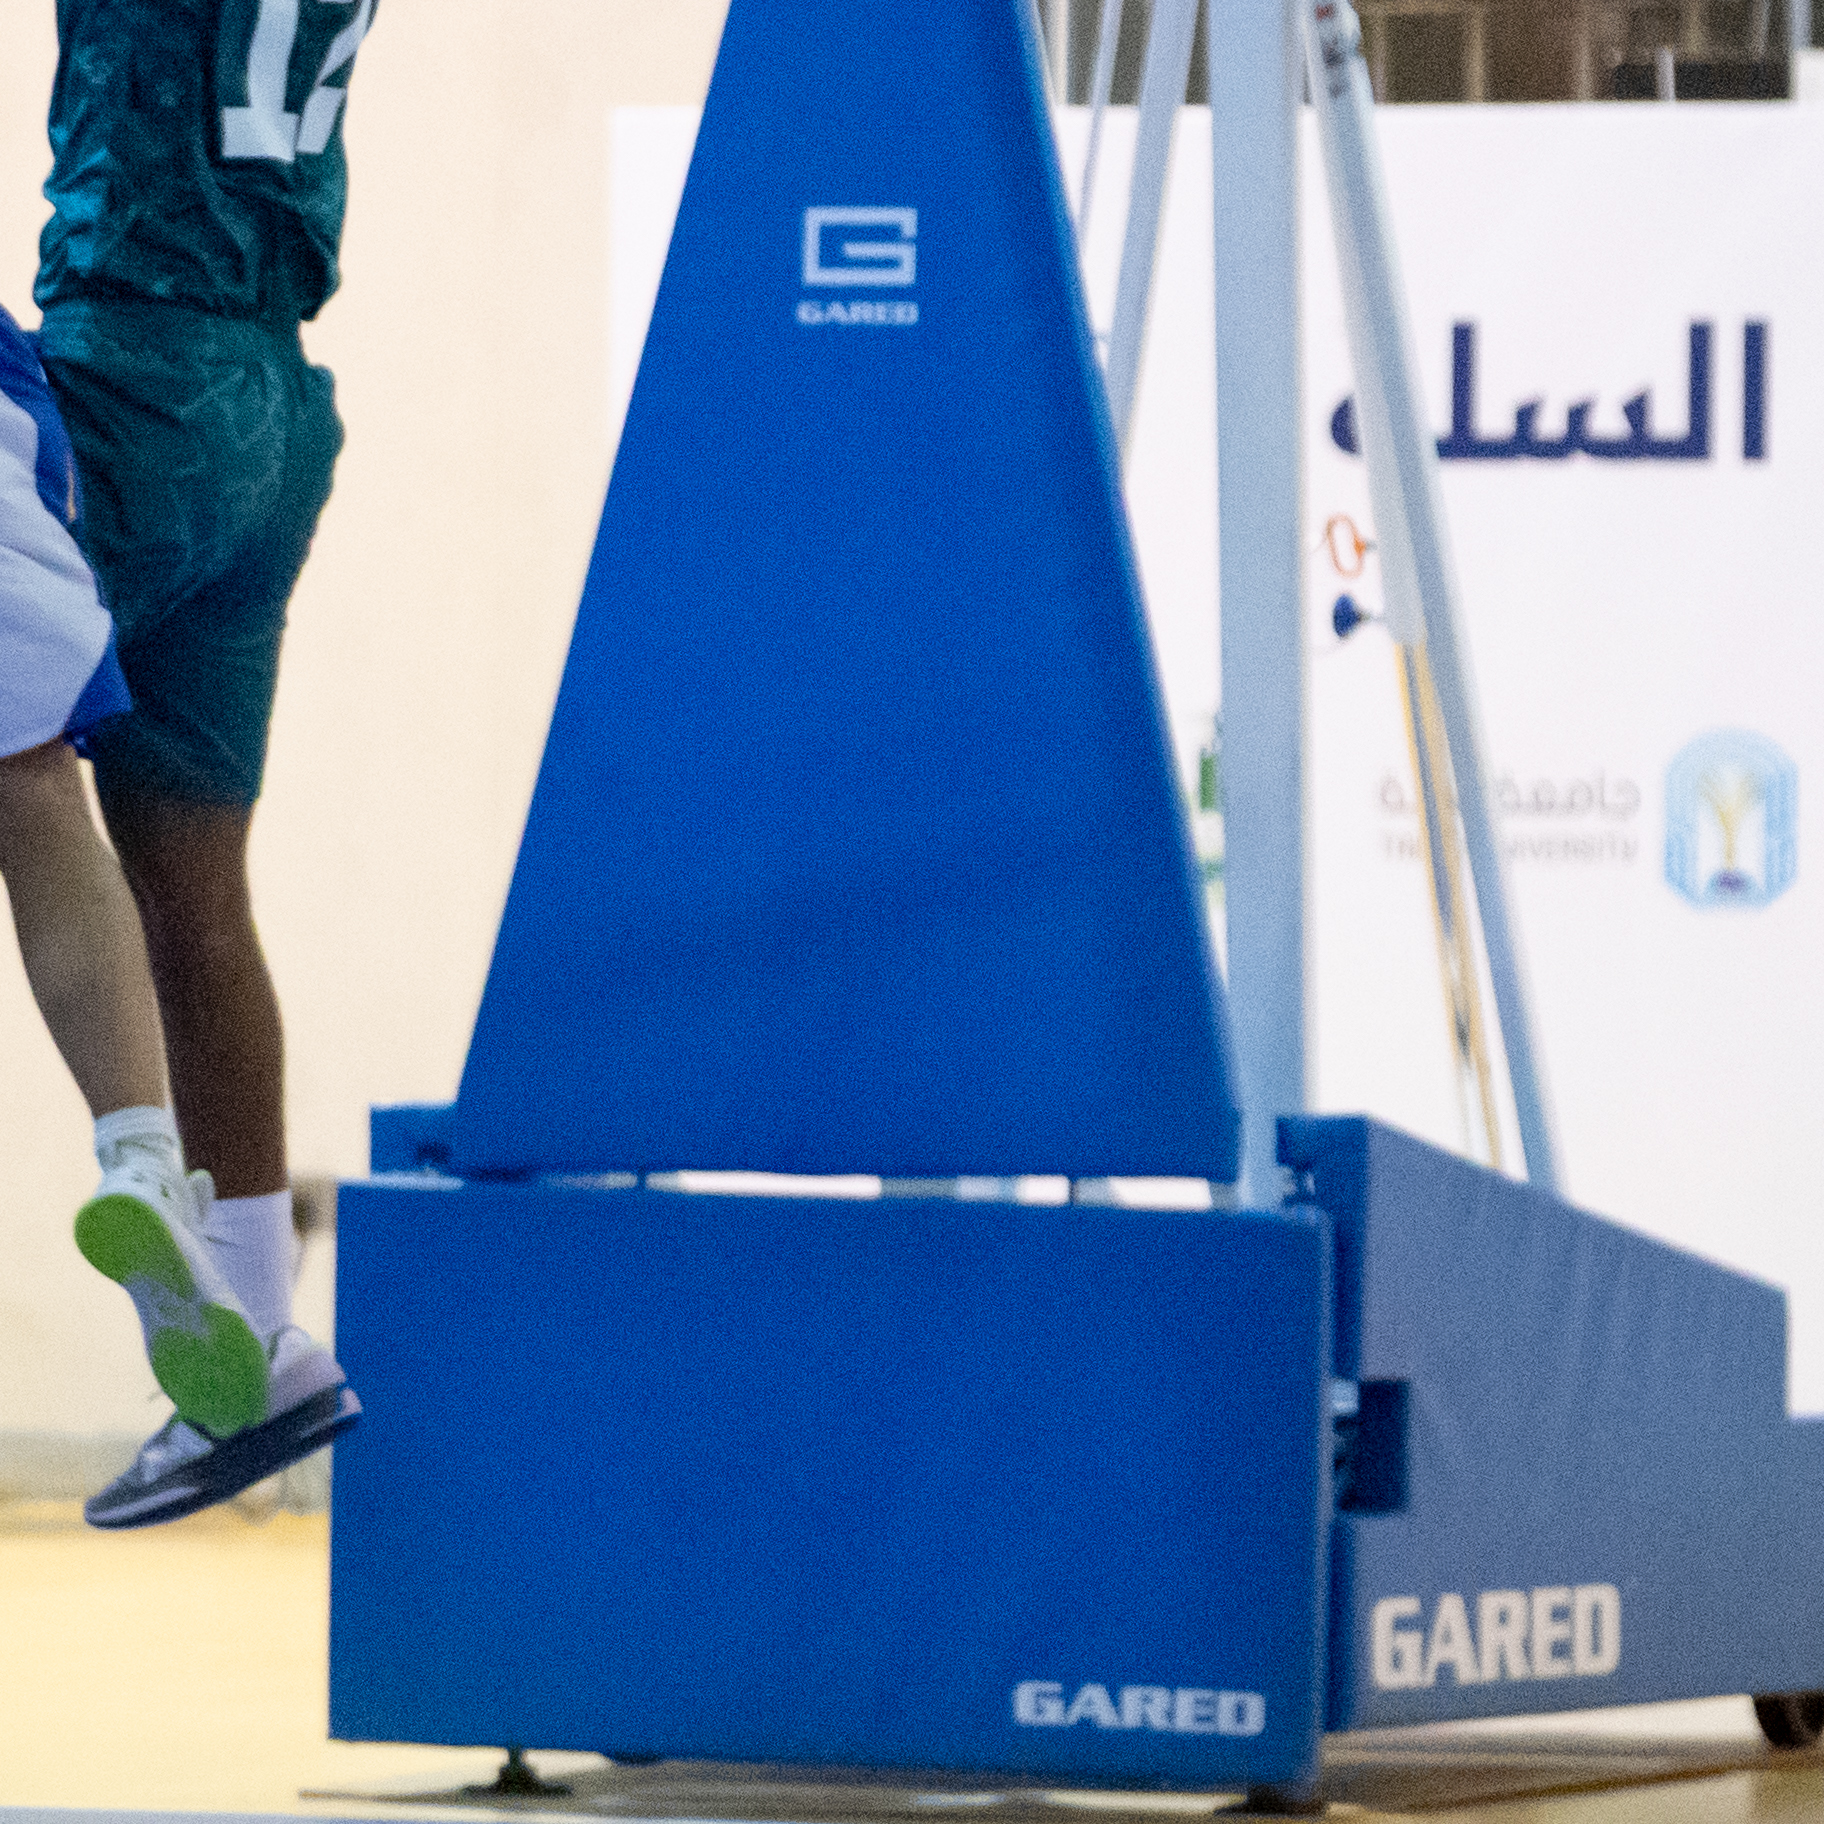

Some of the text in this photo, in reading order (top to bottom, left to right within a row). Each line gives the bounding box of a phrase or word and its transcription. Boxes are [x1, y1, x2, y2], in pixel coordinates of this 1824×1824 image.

[795, 299, 920, 326] GARED
[1372, 1583, 1622, 1691] GARED
[1012, 1680, 1266, 1737] GARED
